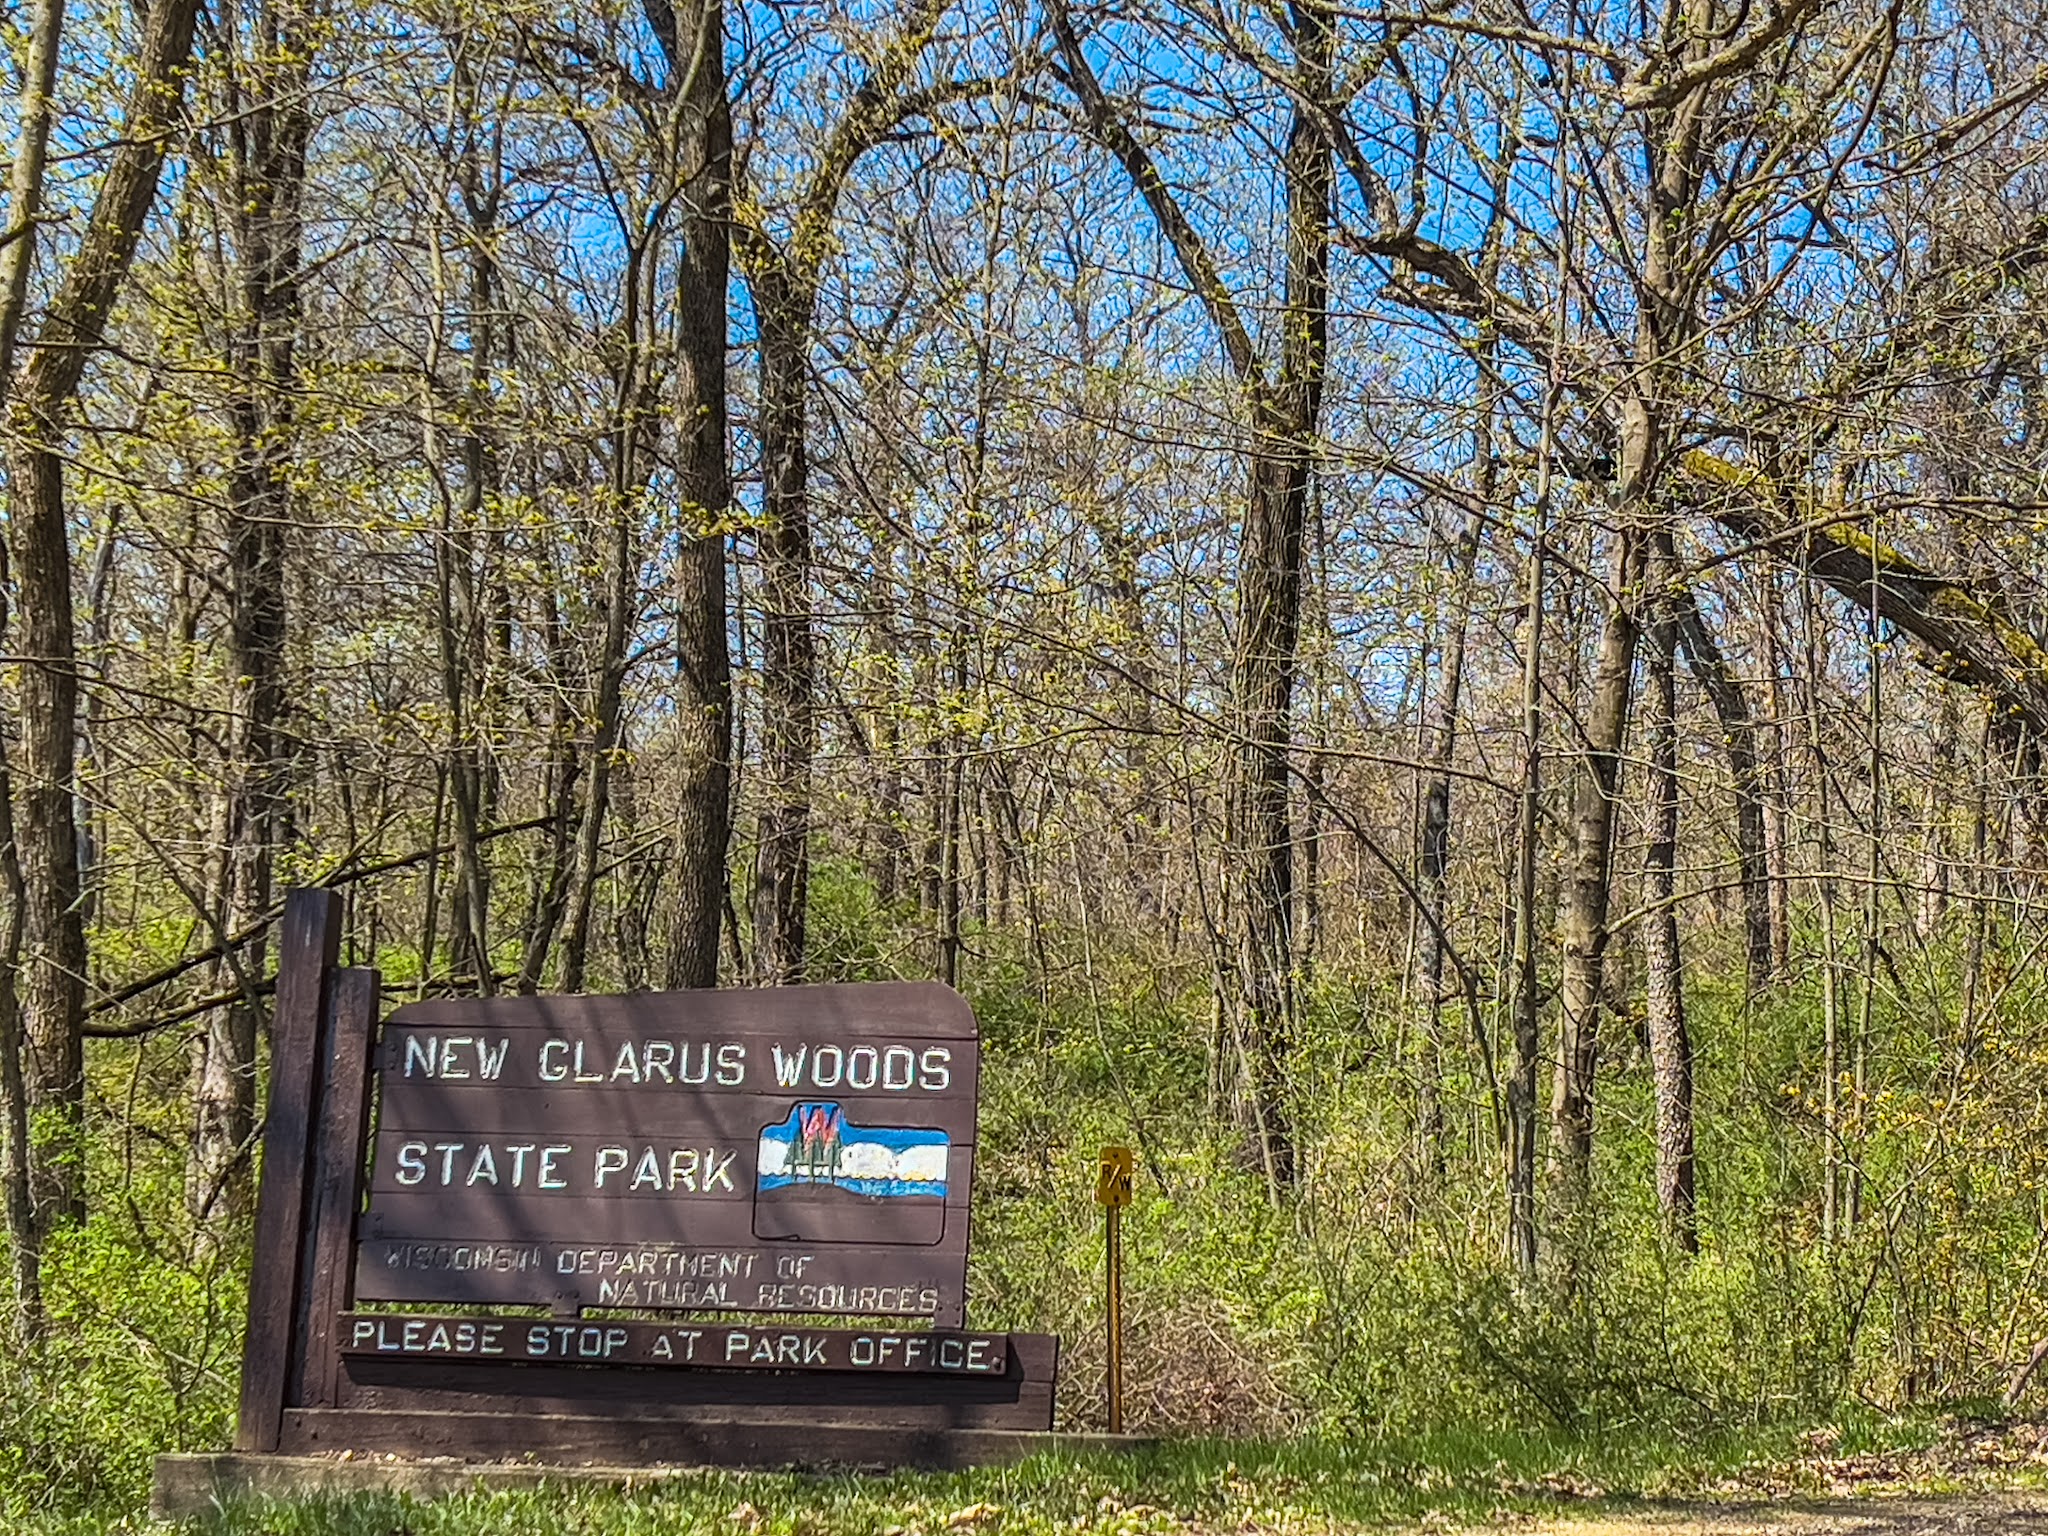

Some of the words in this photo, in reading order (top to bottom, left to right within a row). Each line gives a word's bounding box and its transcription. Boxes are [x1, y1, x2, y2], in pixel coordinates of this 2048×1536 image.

[403, 1035, 509, 1081] NEW
[538, 1038, 747, 1087] GLARUS
[771, 1043, 953, 1091] WOODS
[394, 1141, 572, 1190] STATE
[593, 1147, 739, 1194] PARK
[1101, 1161, 1131, 1191] R/W
[556, 1248, 757, 1279] DEPARTMENT
[776, 1254, 815, 1280] OF
[598, 1278, 738, 1307] NATURAL
[758, 1284, 939, 1313] RESOURCES
[351, 1322, 505, 1355] PLEASE
[525, 1326, 628, 1358] STOP
[651, 1329, 698, 1360] AT
[724, 1333, 829, 1366] PARK
